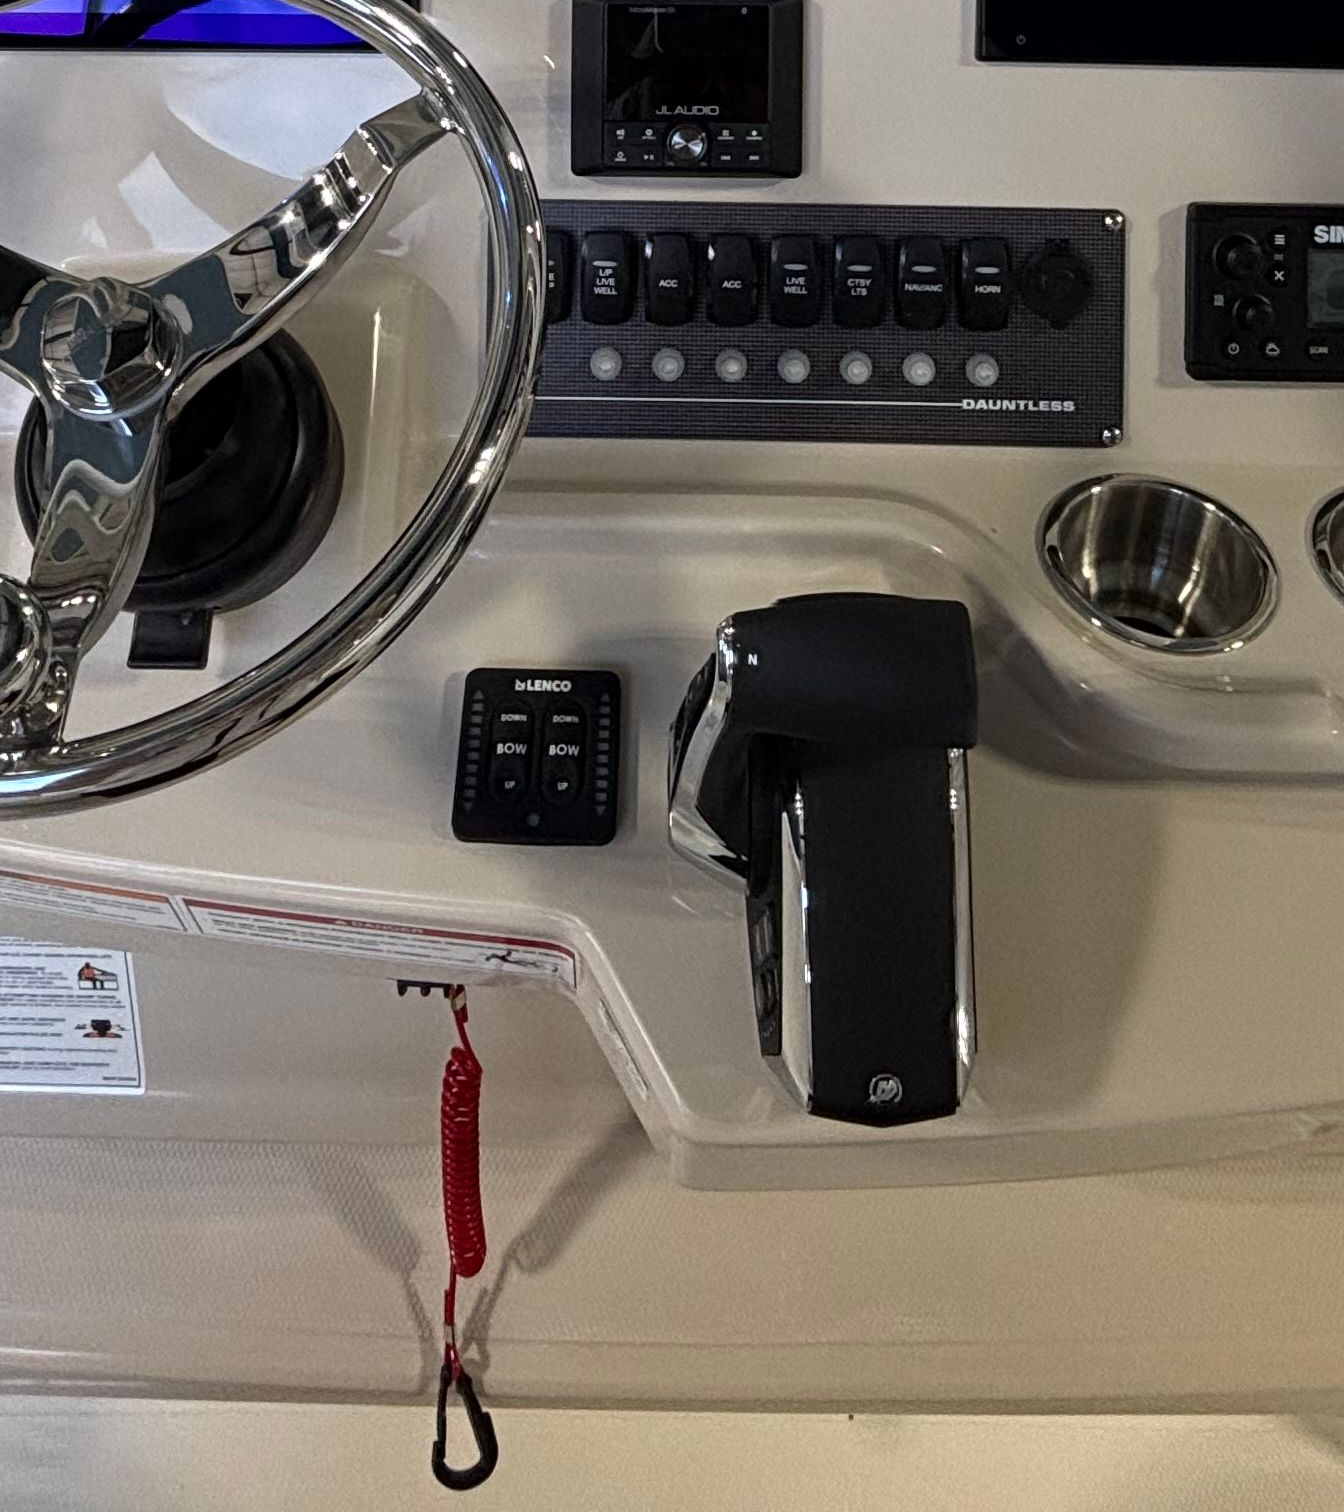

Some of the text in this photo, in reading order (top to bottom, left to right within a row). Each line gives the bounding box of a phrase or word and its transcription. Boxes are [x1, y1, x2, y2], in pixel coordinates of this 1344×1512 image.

[656, 105, 720, 115] JL AUDIO
[596, 278, 616, 286] LIVE
[659, 279, 678, 288] ACC
[722, 280, 742, 289] ACC
[786, 277, 806, 286] LIVE
[847, 278, 872, 287] CTSY
[594, 286, 618, 295] WELL
[784, 286, 808, 295] WELL
[851, 288, 868, 296] LTS
[975, 285, 1001, 294] HORN
[962, 399, 1075, 412] DAUNTLESS
[748, 653, 758, 666] N
[526, 679, 573, 693] LENCO
[501, 714, 527, 723] DOWN
[553, 714, 579, 724] DOWN
[496, 743, 527, 755] BOW
[549, 744, 580, 756] BOW
[504, 781, 516, 789] UP
[557, 782, 569, 791] UP
[351, 920, 424, 935] DANGER
